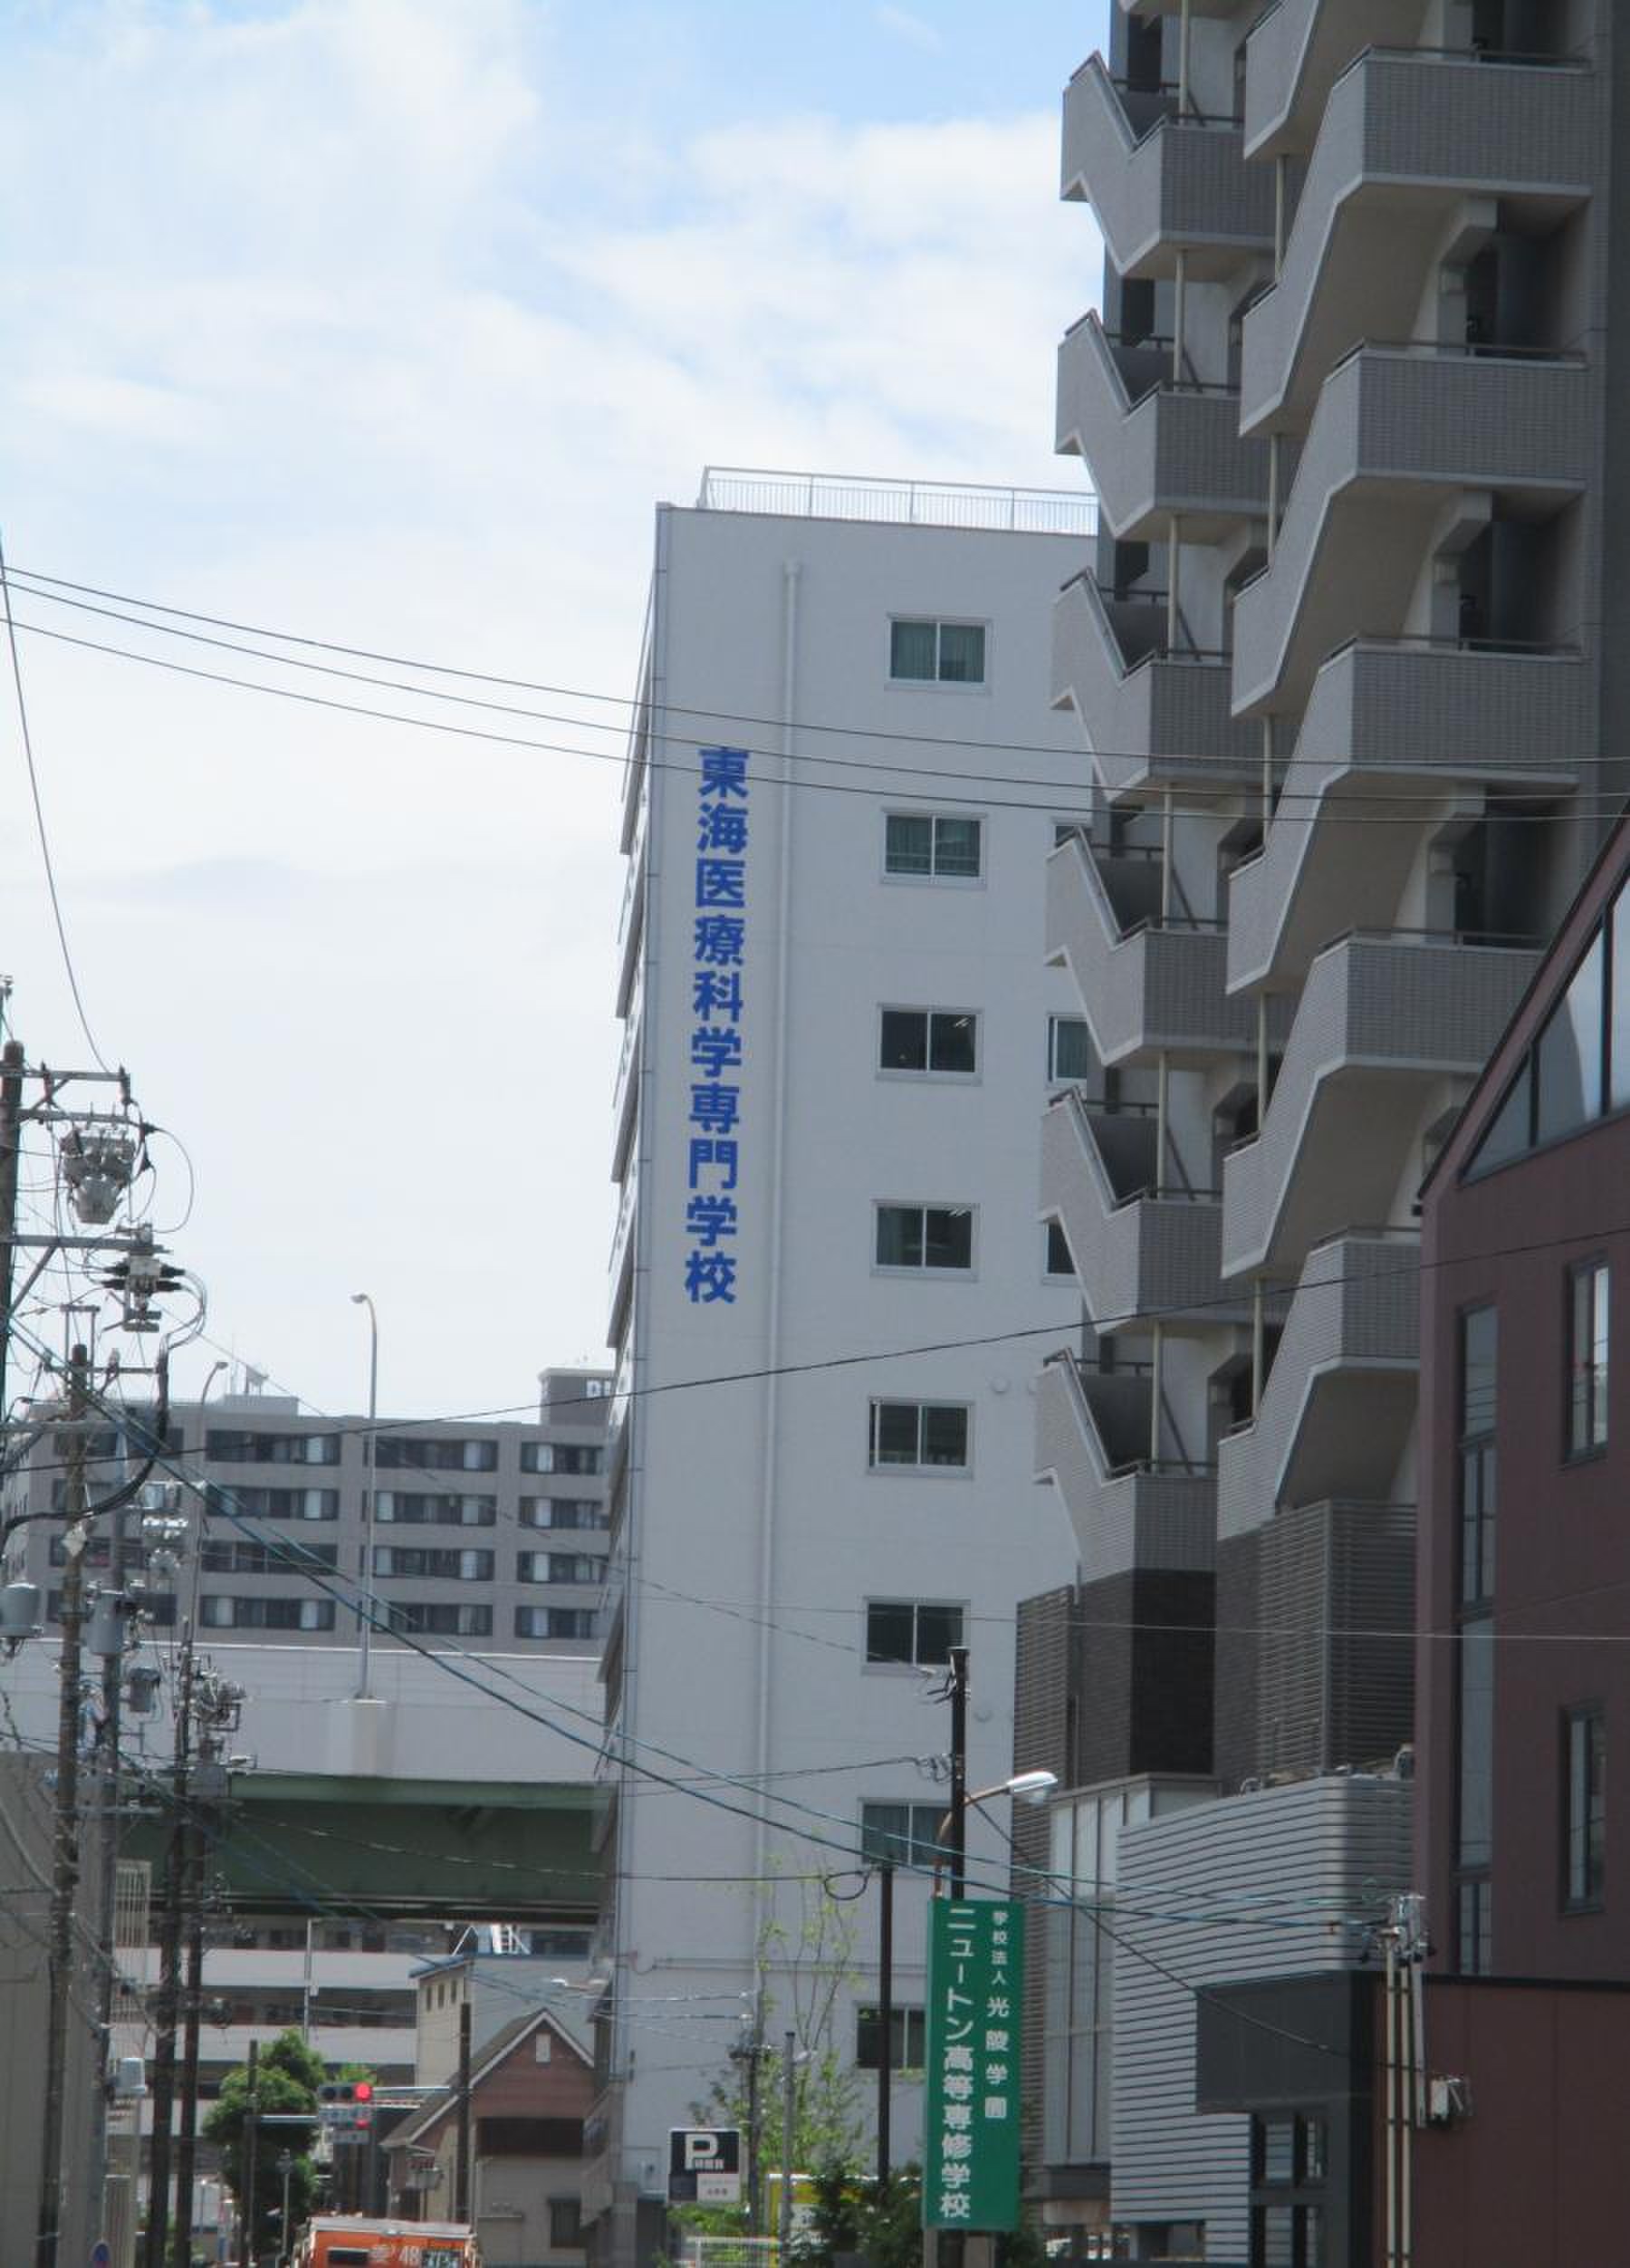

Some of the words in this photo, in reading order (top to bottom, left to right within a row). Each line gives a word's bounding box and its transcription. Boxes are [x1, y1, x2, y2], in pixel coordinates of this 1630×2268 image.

[685, 746, 750, 1304] 東海医療科学専門学校
[686, 2134, 718, 2169] P
[940, 1908, 976, 2218] ニュートン高等専修学校
